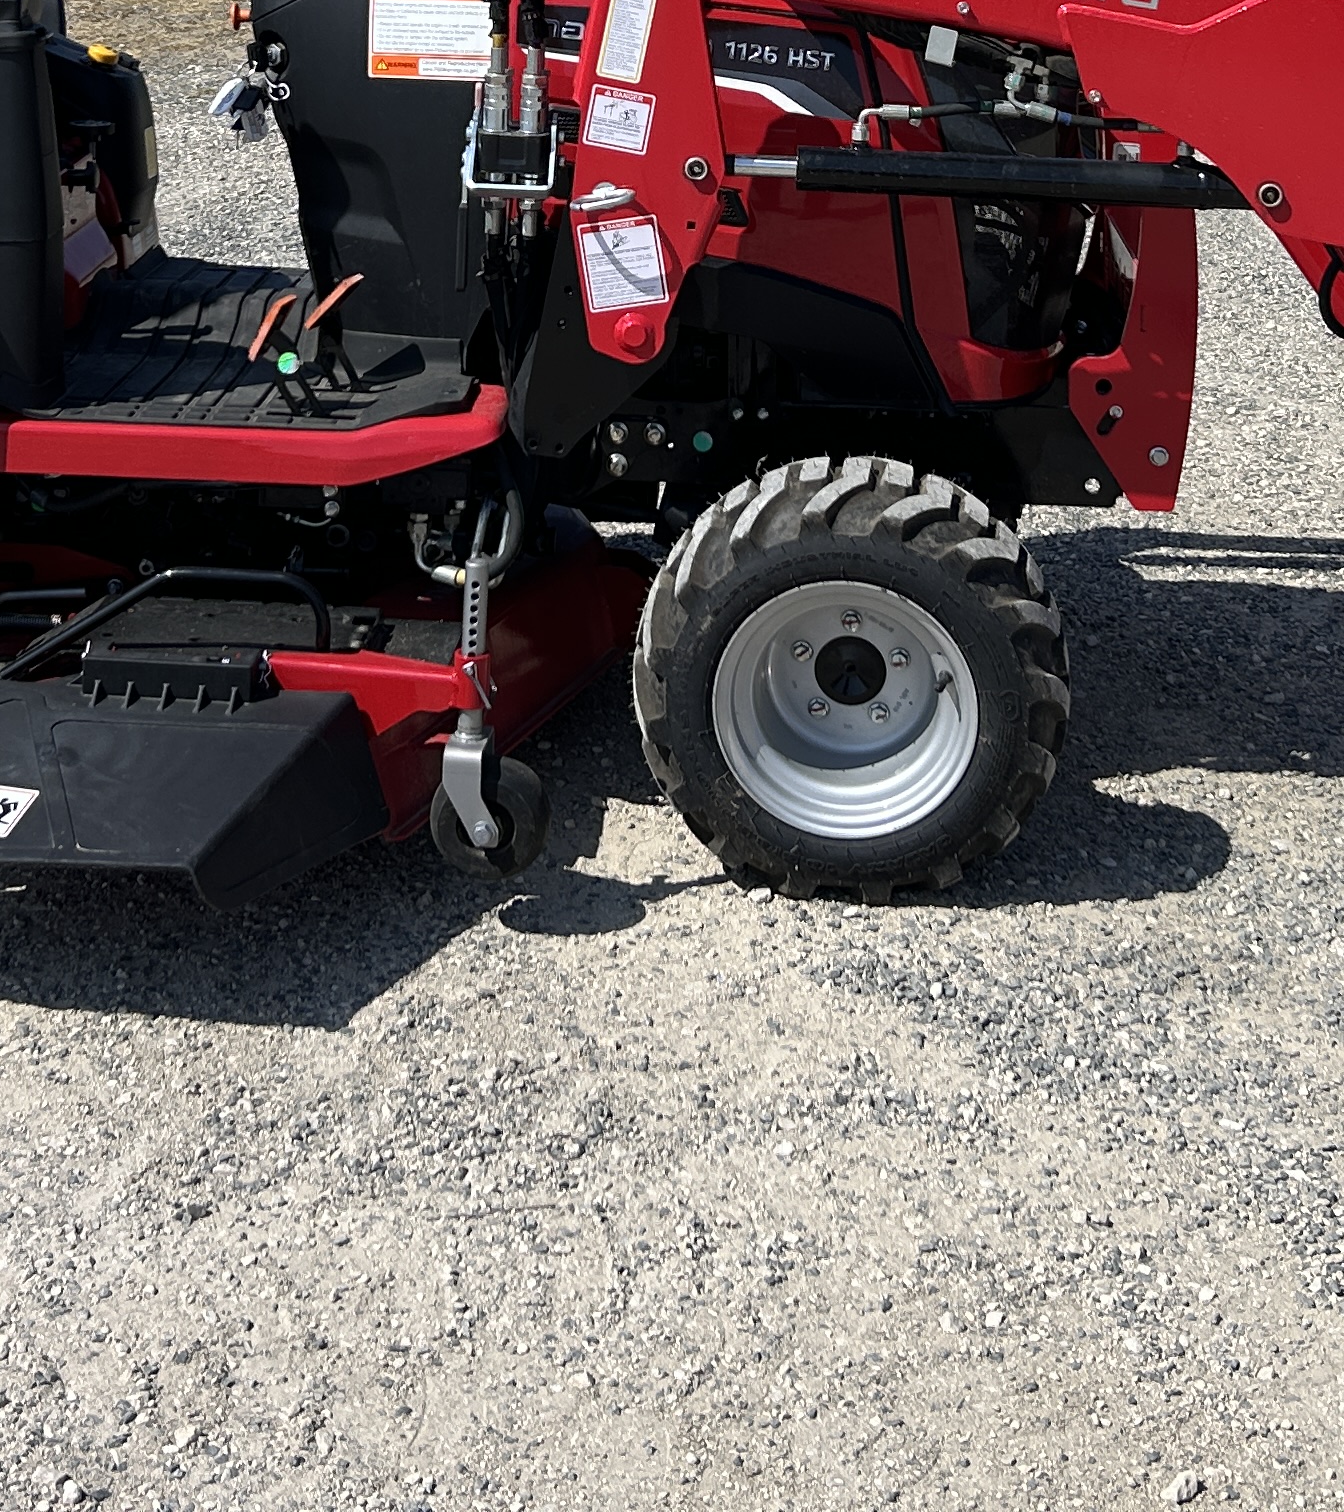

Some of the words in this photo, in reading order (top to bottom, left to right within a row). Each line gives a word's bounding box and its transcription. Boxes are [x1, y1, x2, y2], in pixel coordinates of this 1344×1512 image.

[725, 41, 779, 65] 1126
[787, 47, 836, 71] HST
[612, 90, 644, 102] DANGER
[606, 221, 636, 230] DANGER
